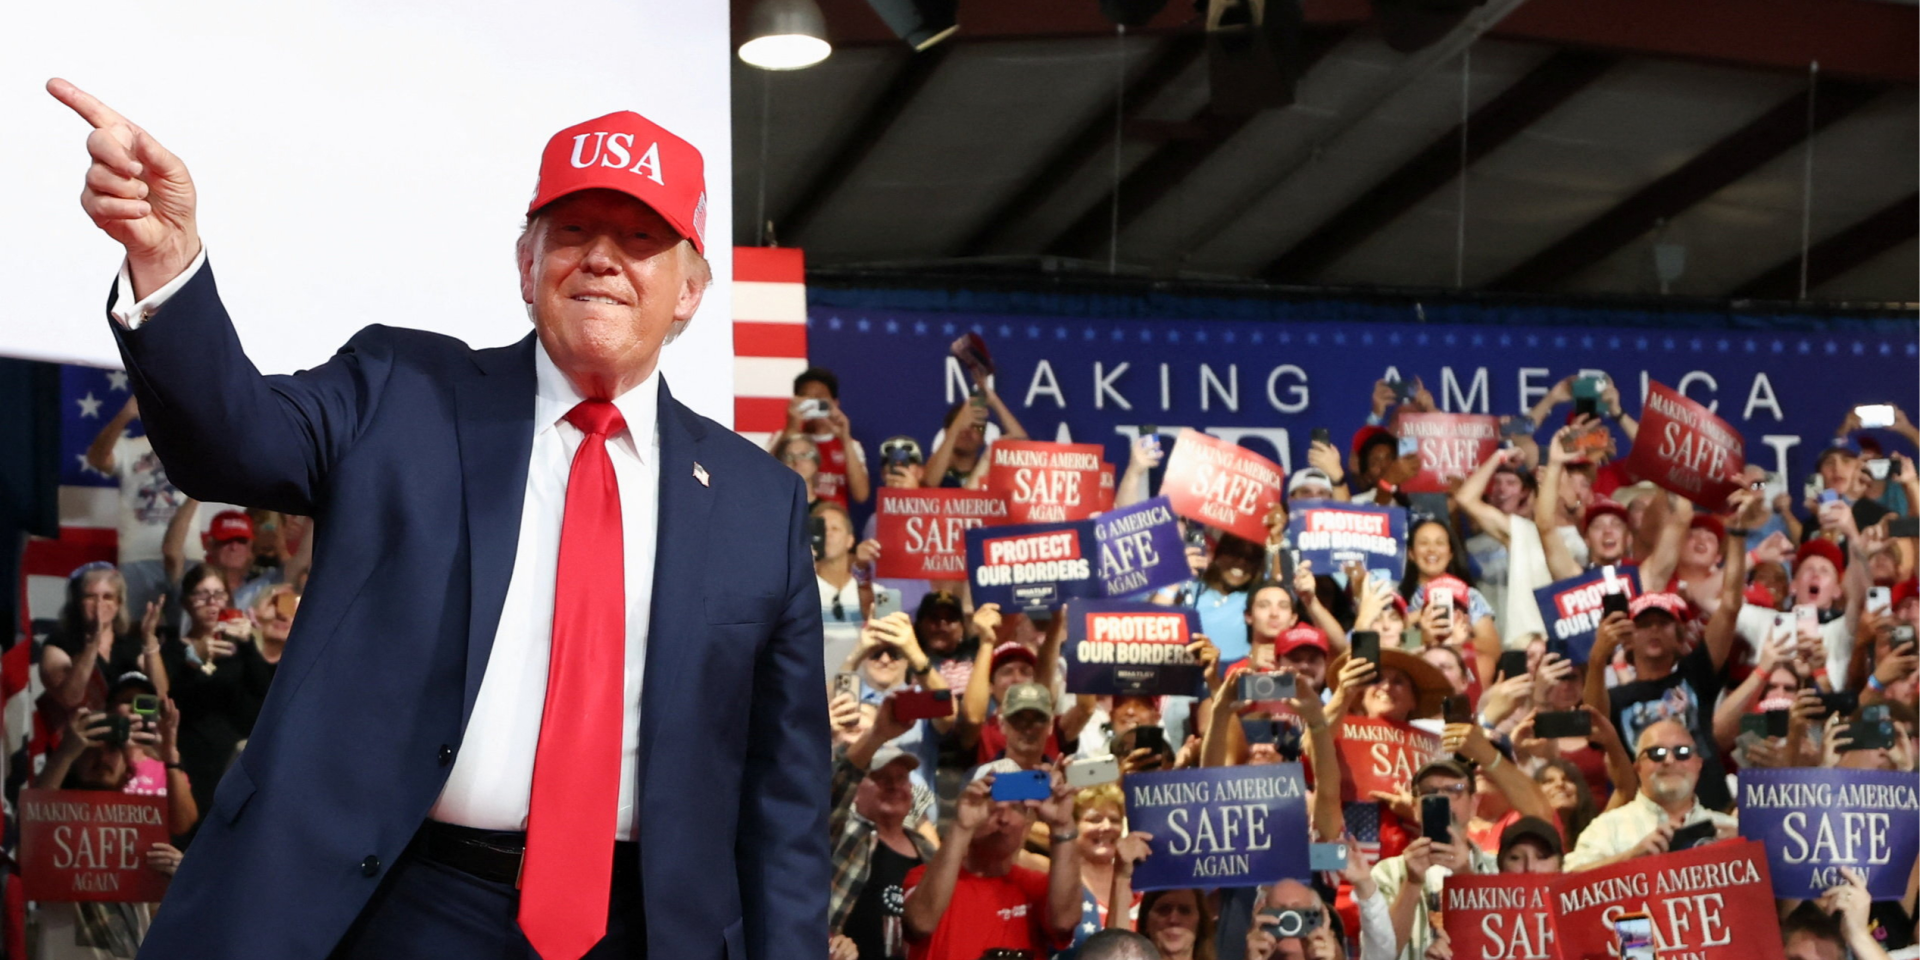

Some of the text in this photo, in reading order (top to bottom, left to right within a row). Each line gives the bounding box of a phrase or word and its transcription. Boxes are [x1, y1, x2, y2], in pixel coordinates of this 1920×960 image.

[569, 131, 665, 187] USA
[1650, 391, 1697, 428] MAKING
[1403, 421, 1447, 437] MAKING
[995, 448, 1099, 471] MAKING AMERICA
[1422, 438, 1480, 471] SAFE
[1658, 421, 1728, 482] SAFE
[1012, 467, 1082, 507] SAFE
[1234, 457, 1281, 491] AMERICA
[1191, 464, 1264, 516] SAFE
[883, 497, 1008, 517] MAKING AMERICA
[1027, 505, 1067, 523] AGAIN
[1199, 501, 1237, 525] AGAIN
[1109, 505, 1172, 537] AMERICA
[1311, 510, 1384, 533] PROTECT
[990, 533, 1073, 564] PROTECT
[1098, 530, 1160, 579] AFE
[1298, 531, 1397, 557] OUR BORDERS
[976, 558, 1091, 587] OUR BORDERS
[1107, 570, 1149, 596] AGAIN
[1093, 616, 1181, 642] PROTECT
[1554, 612, 1591, 639] OUR
[1077, 640, 1197, 665] OUR BORDERS
[1343, 723, 1405, 745] MAKING
[1134, 775, 1300, 808] MAKING AMERICA
[1745, 783, 1919, 810] MAKING AMERICA
[26, 801, 163, 825] MAKING AMERICA
[1167, 803, 1272, 855] SAFE
[1782, 811, 1892, 865] SAFE
[53, 825, 140, 870] SAFE
[1192, 854, 1250, 877] AGAIN
[72, 872, 120, 891] AGAIN
[1559, 872, 1649, 915] MAKING
[1655, 859, 1761, 895] AMERICA
[1448, 886, 1526, 910] MAKING
